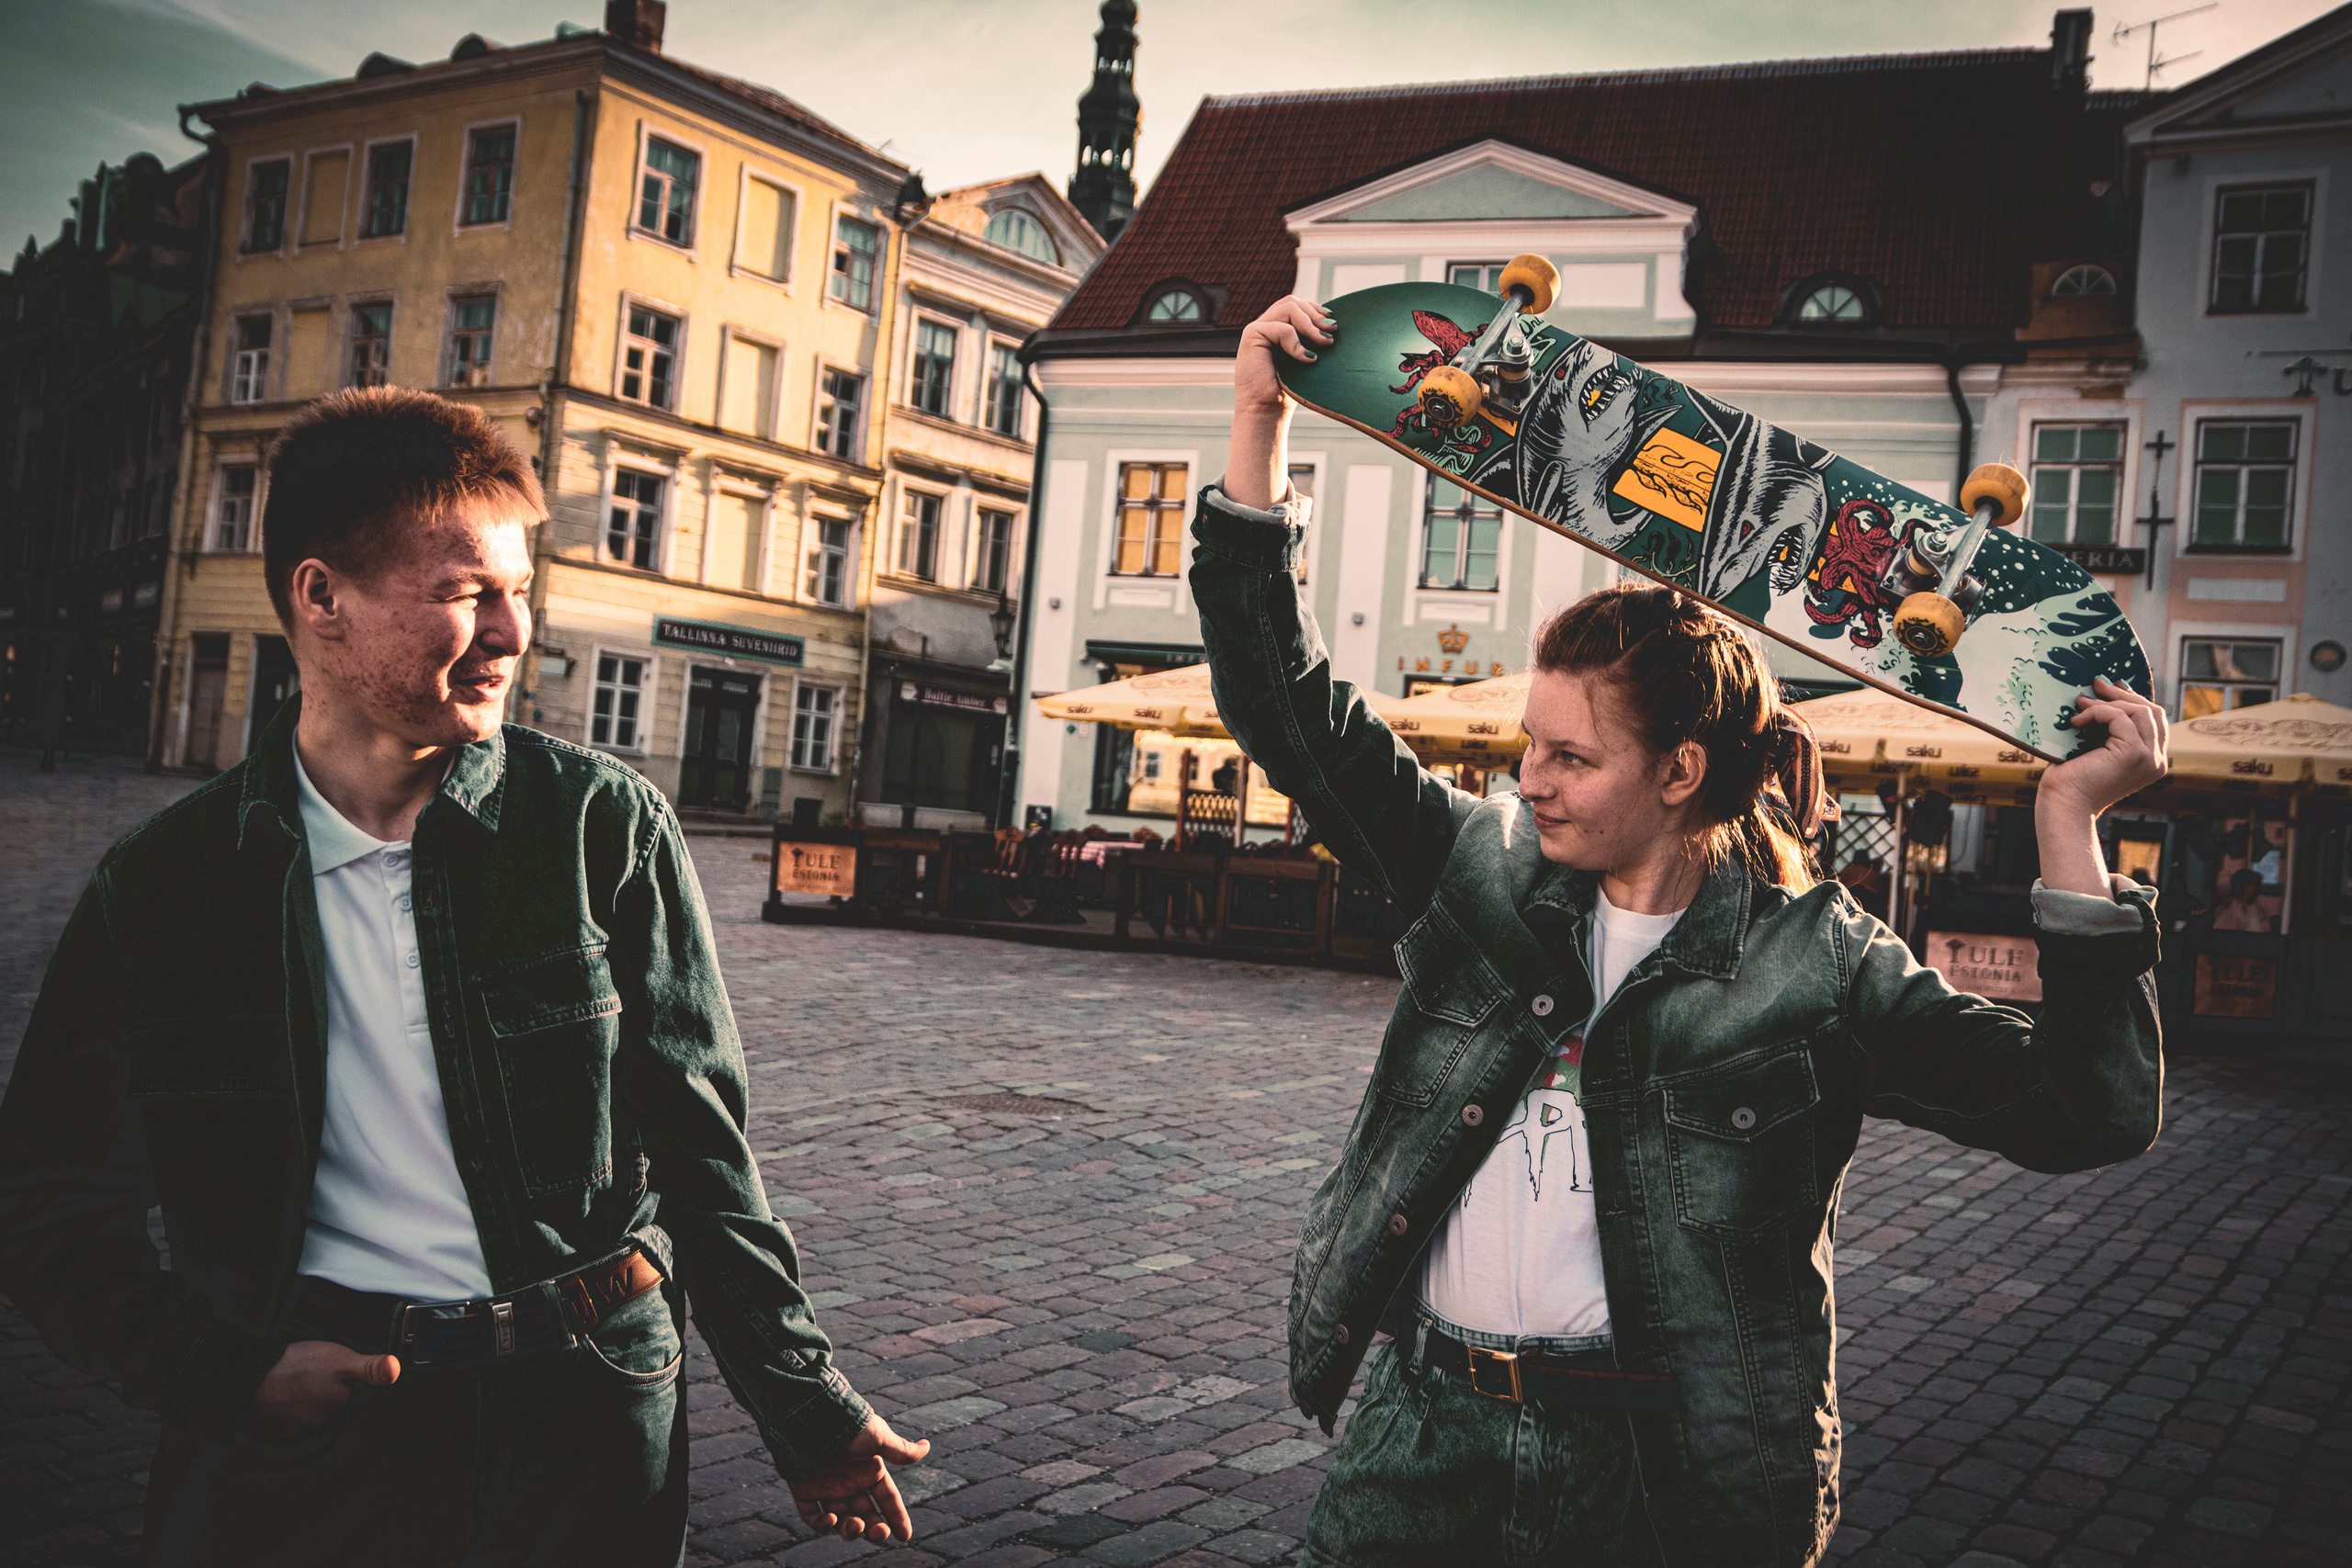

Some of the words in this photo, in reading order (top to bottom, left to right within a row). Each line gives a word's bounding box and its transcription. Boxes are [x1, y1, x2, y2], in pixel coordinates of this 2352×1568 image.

[664, 624, 727, 646] TALLINNA
[924, 687, 953, 703] Baltic
[1067, 704, 1094, 715] saku
[1134, 706, 1163, 720] saku
[1389, 718, 1420, 731] saku
[1467, 722, 1499, 735] saku
[1818, 739, 1851, 754] saku
[1906, 743, 1942, 759] saku
[1997, 750, 2035, 763] saku
[2232, 758, 2274, 775] saku
[1949, 964, 2022, 981] ESTONIA
